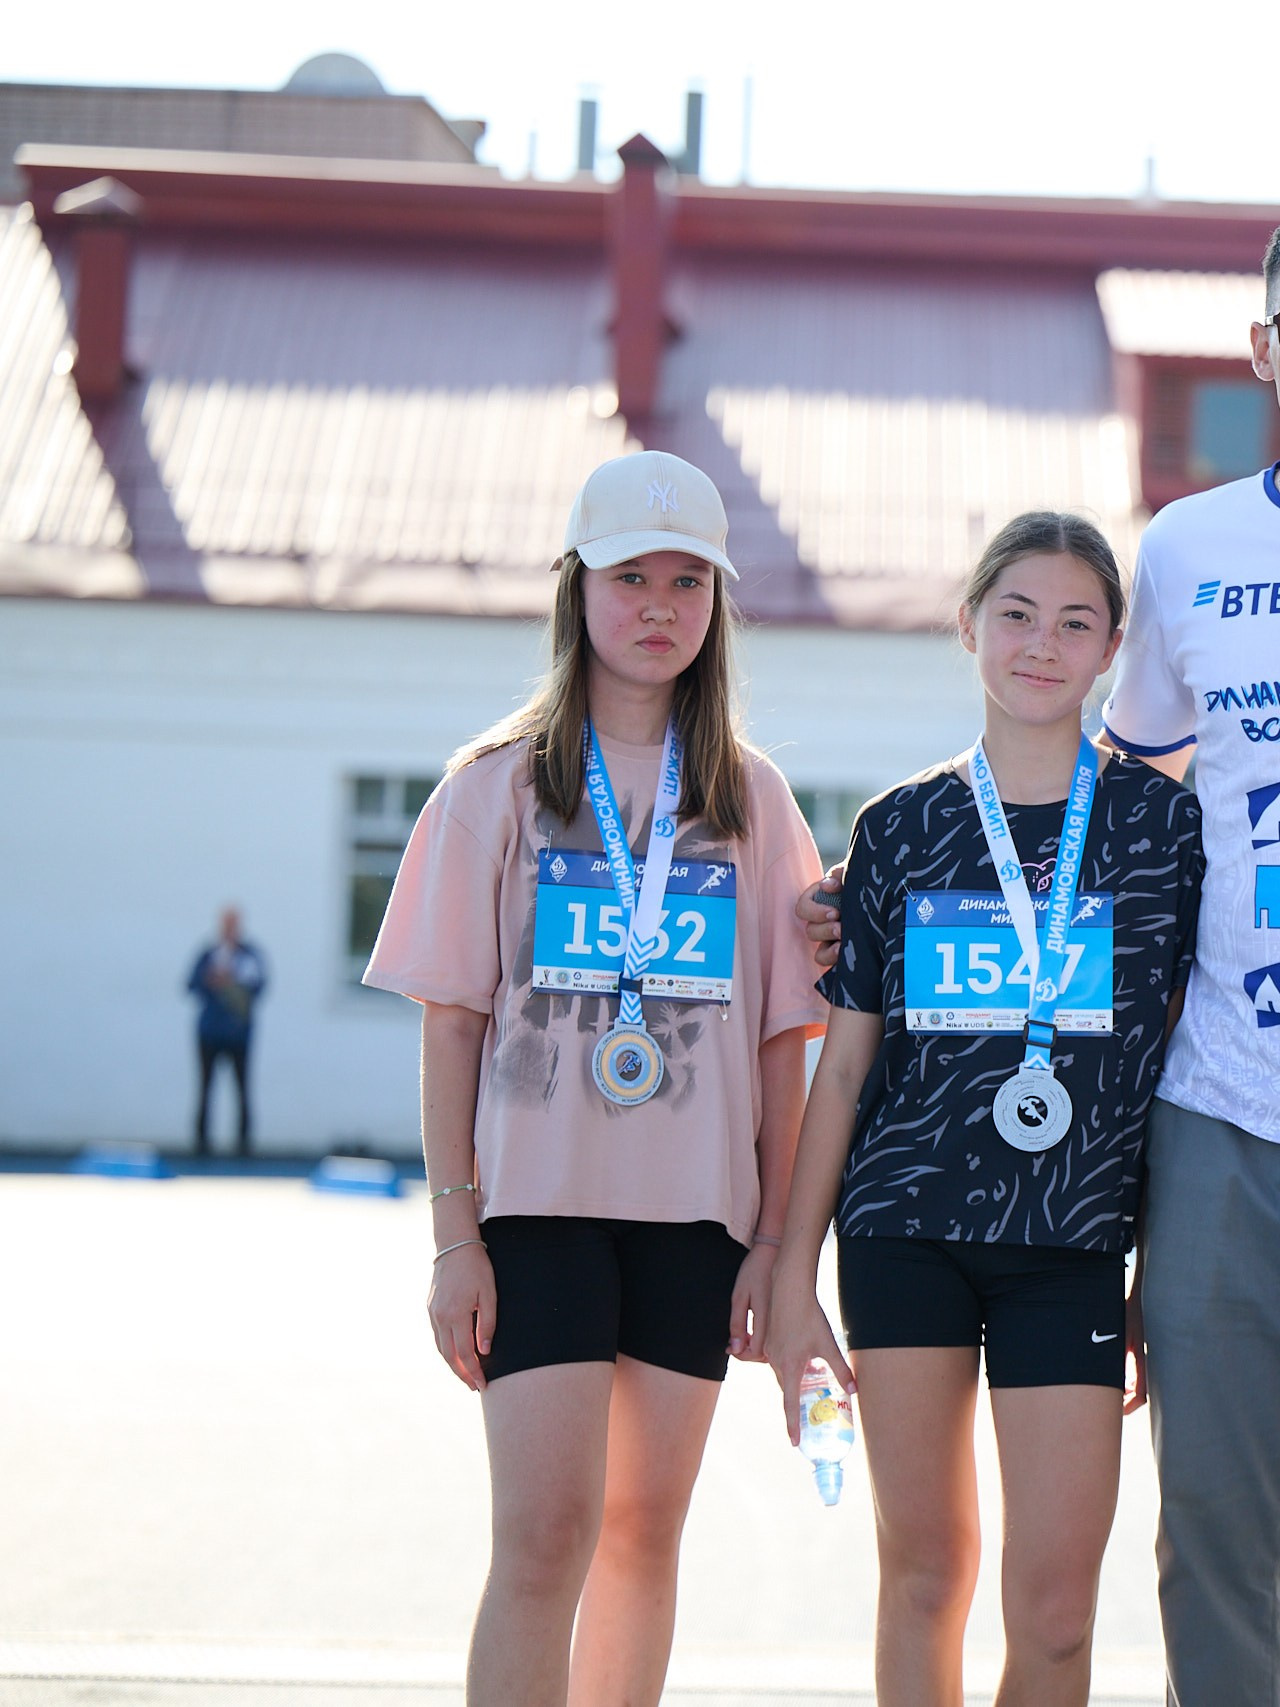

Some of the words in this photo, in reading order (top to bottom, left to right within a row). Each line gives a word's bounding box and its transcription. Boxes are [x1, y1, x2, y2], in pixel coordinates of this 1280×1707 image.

[978, 780, 1007, 840] БЕЖИТ!
[1046, 816, 1085, 954] ДИНАМОВСКАЯ
[1072, 765, 1093, 812] МИЛЯ
